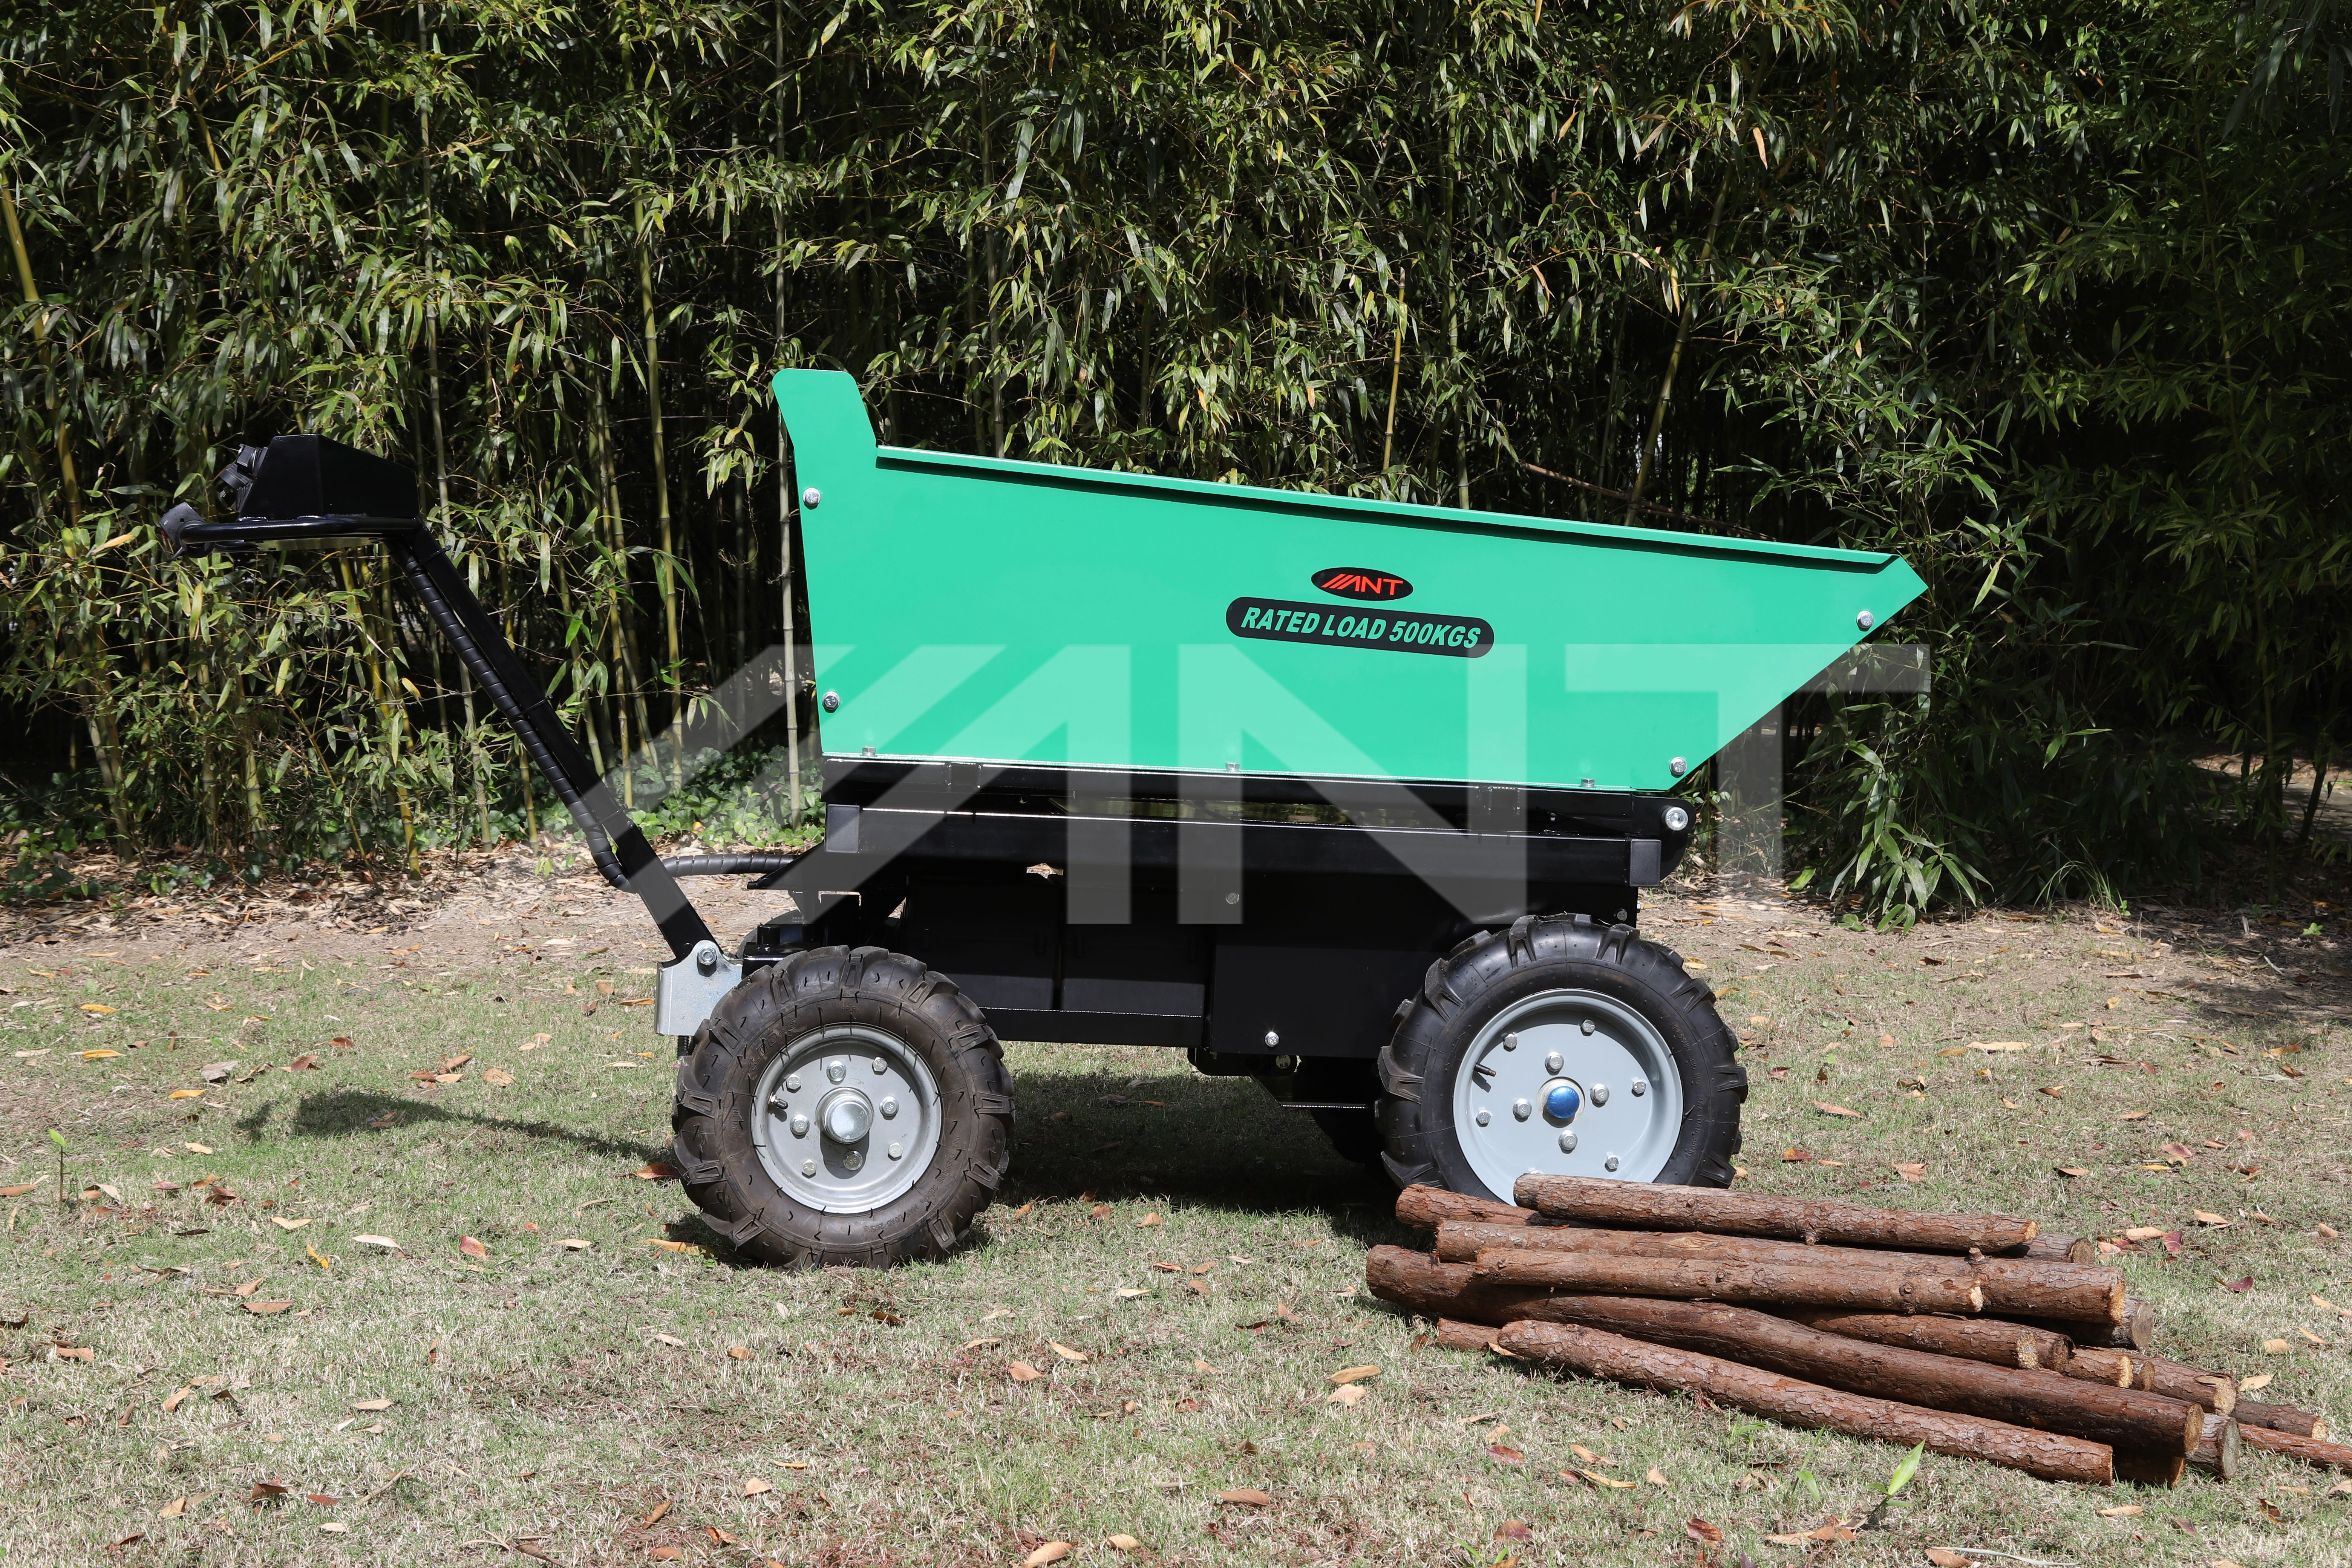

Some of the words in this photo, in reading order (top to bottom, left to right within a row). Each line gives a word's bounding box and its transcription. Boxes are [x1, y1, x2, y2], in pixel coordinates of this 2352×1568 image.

[1321, 574, 1403, 596] ANT
[1240, 607, 1320, 634] RATED
[1321, 614, 1386, 640] LOAD
[1389, 620, 1481, 648] 500KGS
[1658, 1007, 1670, 1021] INFL
[1670, 1022, 1692, 1054] PRESSURE
[937, 1153, 956, 1184] PRESSURE
[887, 1214, 905, 1227] LOAD
